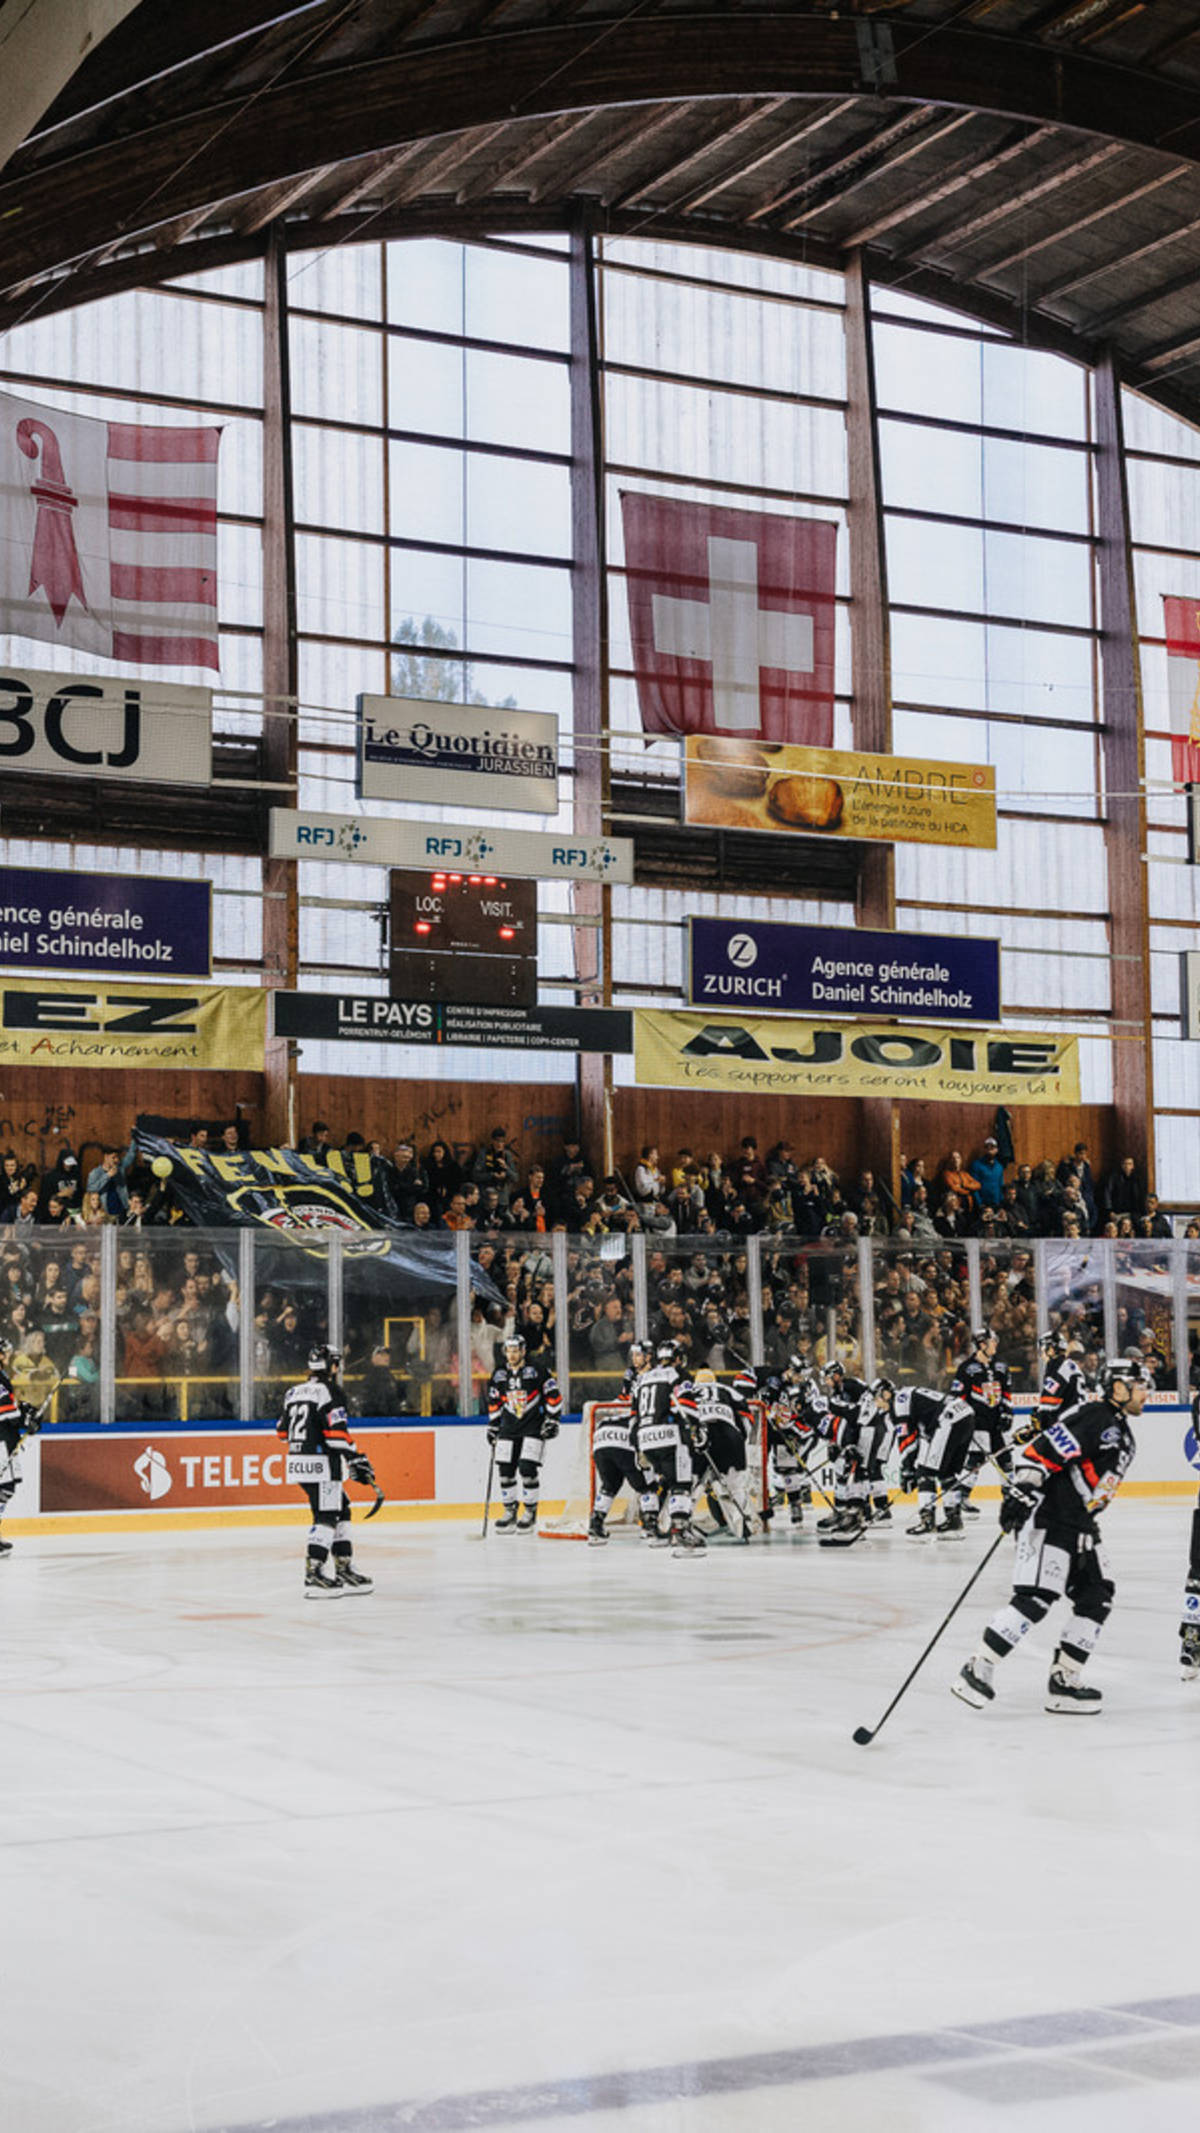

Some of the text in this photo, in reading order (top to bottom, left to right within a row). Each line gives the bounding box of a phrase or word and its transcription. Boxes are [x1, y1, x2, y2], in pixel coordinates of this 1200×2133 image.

[365, 718, 555, 761] Le Quotidien
[476, 757, 554, 778] JURASSIEN
[852, 765, 968, 805] AMBRE
[902, 803, 931, 817] future
[297, 826, 334, 846] RFJ
[944, 821, 969, 834] HCA
[425, 837, 462, 857] RFJ
[552, 848, 587, 866] RFJ
[48, 905, 144, 931] générale
[415, 896, 514, 917] LOC. VISIT.
[36, 933, 174, 961] Schindelholz
[811, 956, 950, 983] Agence générale
[703, 974, 782, 997] ZURICH
[812, 981, 972, 1008] Daniel Schindelholz
[2, 990, 201, 1034] EZ
[338, 999, 433, 1026] LE PAYS
[30, 1036, 201, 1058] Acharnement
[679, 1024, 1061, 1074] AJOIE
[728, 1070, 850, 1086] supporters
[860, 1075, 928, 1087] seront
[939, 1079, 1018, 1097] toujours
[288, 1403, 309, 1442] 12
[179, 1454, 291, 1488] TELEC
